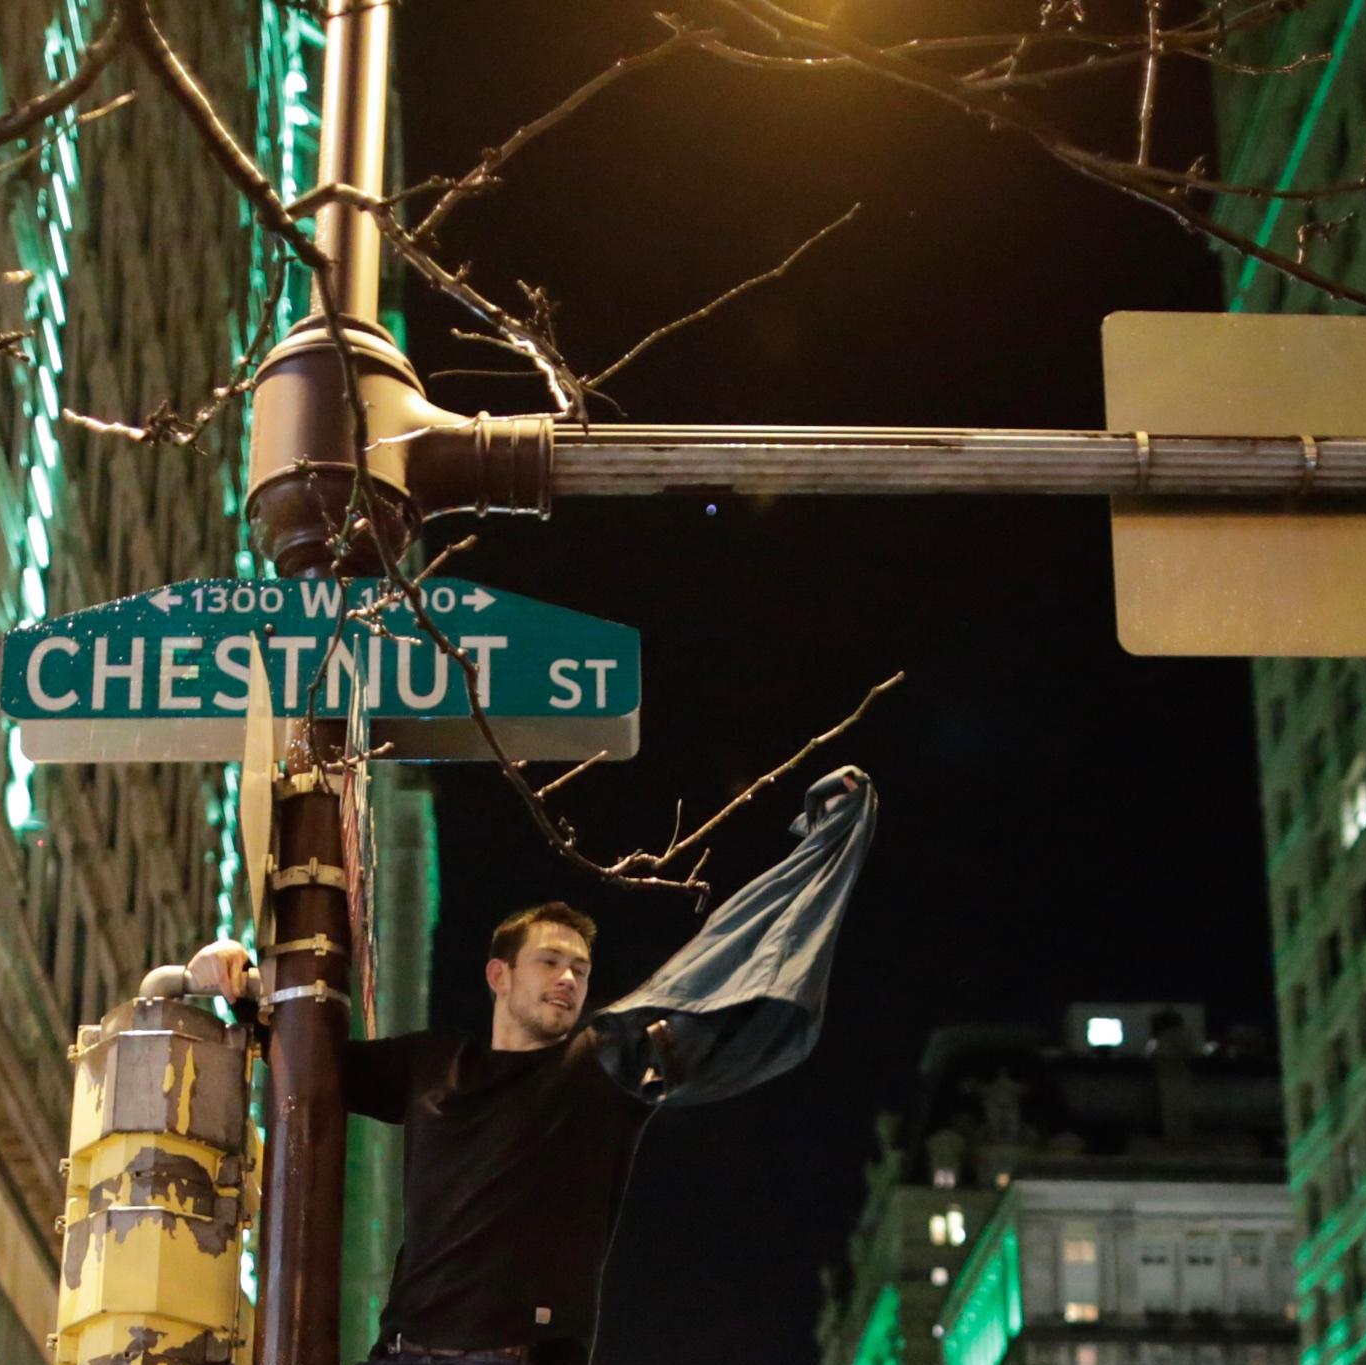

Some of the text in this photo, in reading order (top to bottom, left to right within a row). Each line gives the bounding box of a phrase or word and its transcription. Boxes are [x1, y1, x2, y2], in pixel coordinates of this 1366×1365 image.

[191, 581, 456, 618] 1300 W 100
[26, 635, 617, 711] CHESTNUT ST
